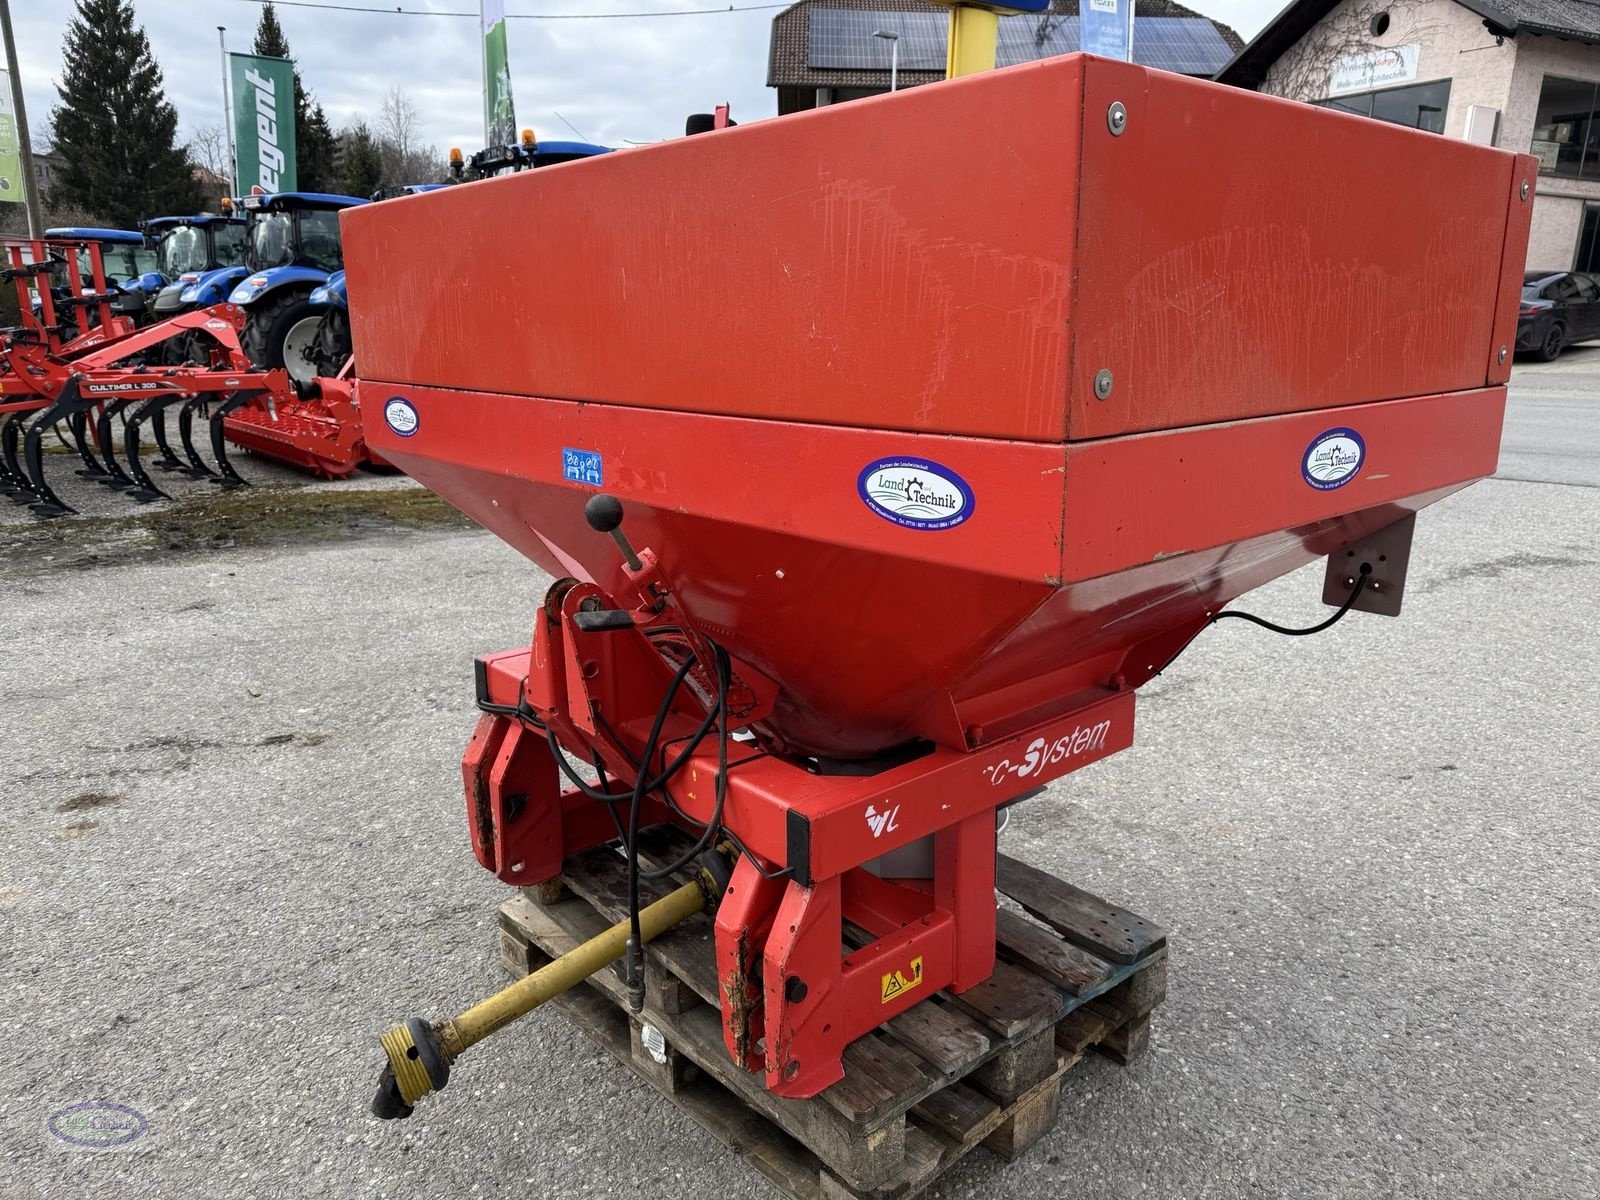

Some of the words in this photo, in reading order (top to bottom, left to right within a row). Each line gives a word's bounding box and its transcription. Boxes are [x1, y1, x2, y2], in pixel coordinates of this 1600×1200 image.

[89, 384, 132, 392] CULTIMER
[878, 475, 906, 492] Land
[913, 490, 957, 509] Technik
